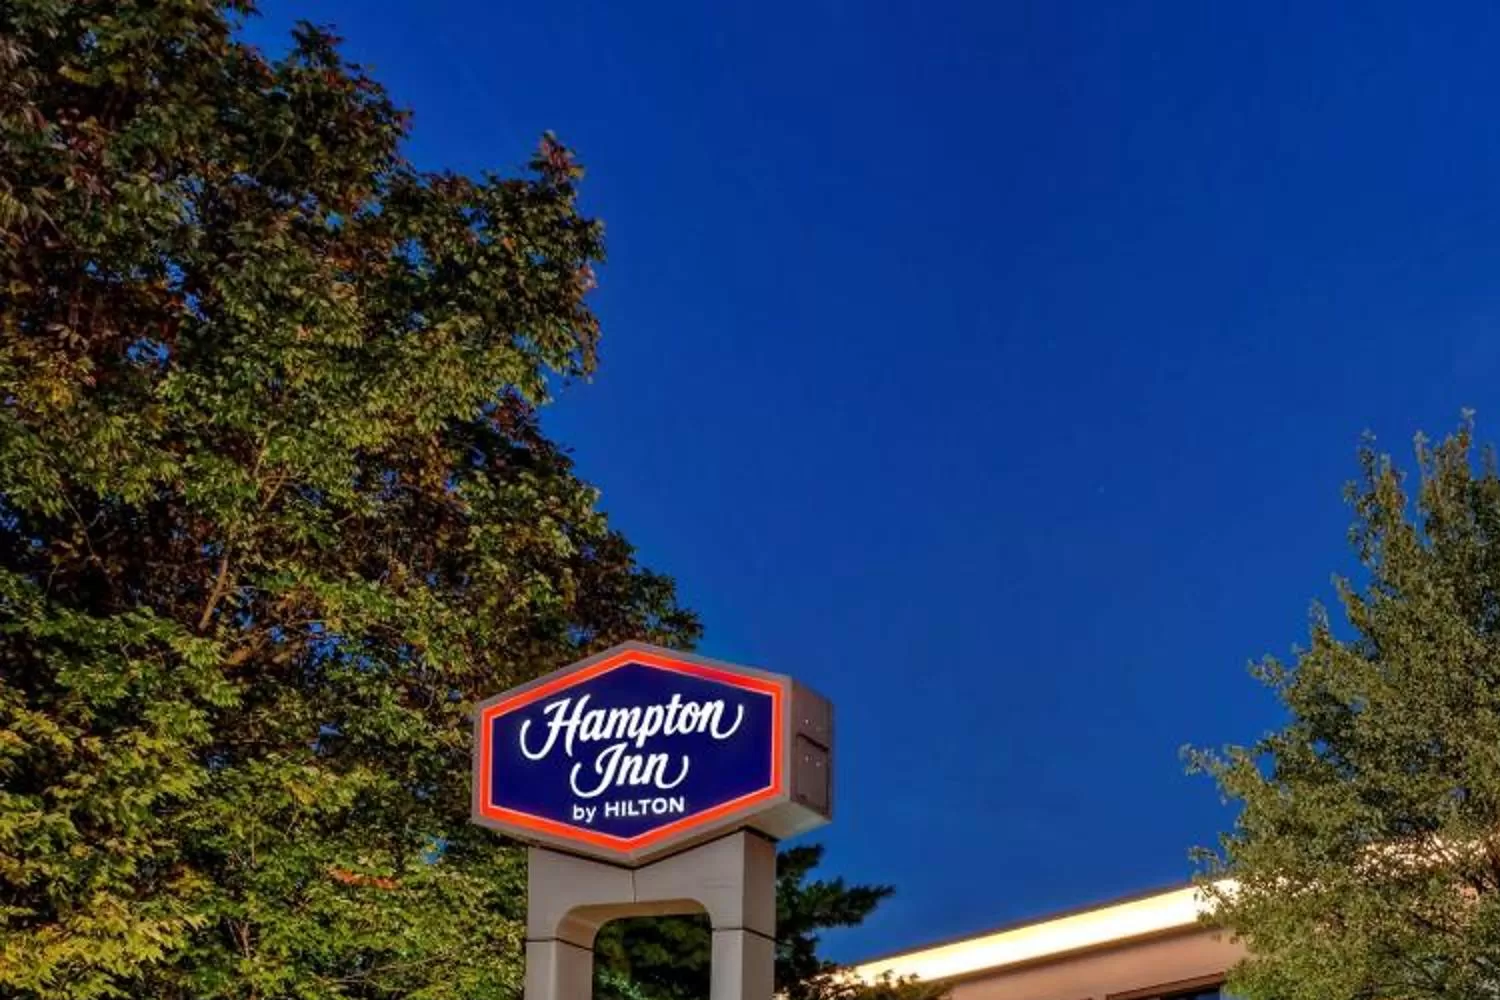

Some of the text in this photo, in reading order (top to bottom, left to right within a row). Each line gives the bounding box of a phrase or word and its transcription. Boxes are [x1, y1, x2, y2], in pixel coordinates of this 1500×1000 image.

[519, 693, 744, 761] Hampton
[569, 742, 689, 798] Inn
[572, 796, 685, 822] by HILTON
